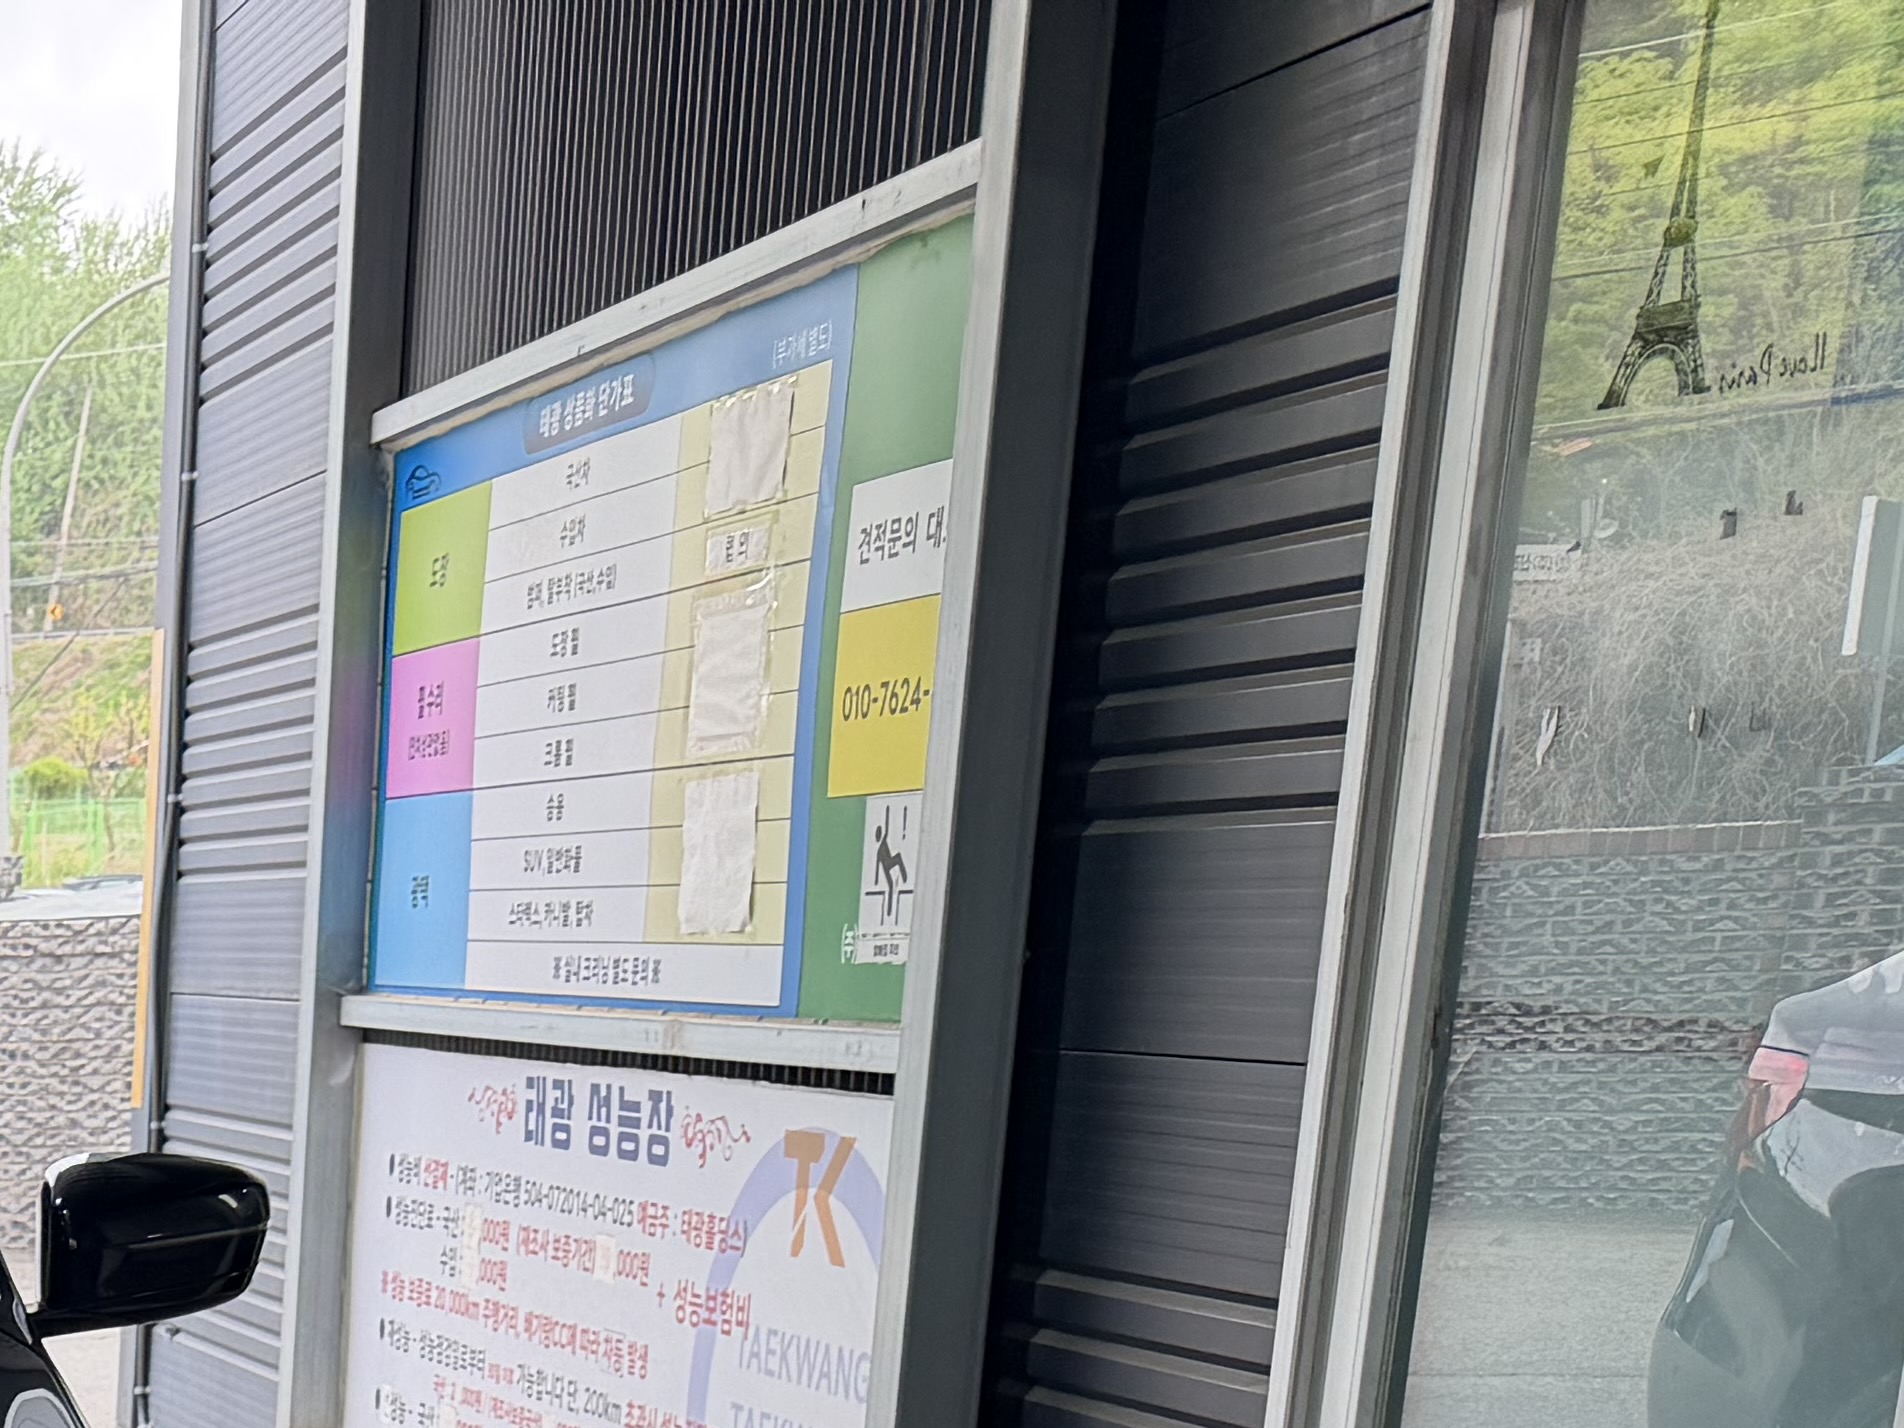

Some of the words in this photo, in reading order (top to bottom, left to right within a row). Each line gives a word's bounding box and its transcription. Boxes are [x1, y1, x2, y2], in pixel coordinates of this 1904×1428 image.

[539, 401, 561, 438] 태광
[563, 388, 595, 431] 상품화
[598, 373, 634, 416] 단가표
[566, 457, 590, 490] 국산차
[560, 514, 586, 548] 수입차
[858, 512, 919, 565] 견적문의
[925, 506, 946, 549] 대
[842, 676, 930, 722] 010-7624-
[546, 793, 565, 822] 승용
[524, 1076, 574, 1150] 태광
[588, 1083, 674, 1167] 성능장
[484, 1169, 521, 1208] 기업은행
[523, 1178, 635, 1228] 504-072014-04-025
[636, 1198, 670, 1240] 예금주
[680, 1207, 748, 1259] 태광홀딩스)
[784, 1130, 857, 1267] TK
[394, 1194, 434, 1233] 성능진단료
[516, 1223, 550, 1262] (제조사
[551, 1230, 597, 1274] 보증기간)
[671, 1275, 752, 1341] 성능보험비
[579, 1324, 601, 1364] 따라
[601, 1332, 625, 1375] 차등
[626, 1338, 649, 1381] 발생
[738, 1326, 870, 1404] TAEKWANG
[383, 1388, 406, 1426] 성능
[515, 1361, 564, 1409] 가능합니다
[583, 1384, 622, 1426] 200km
